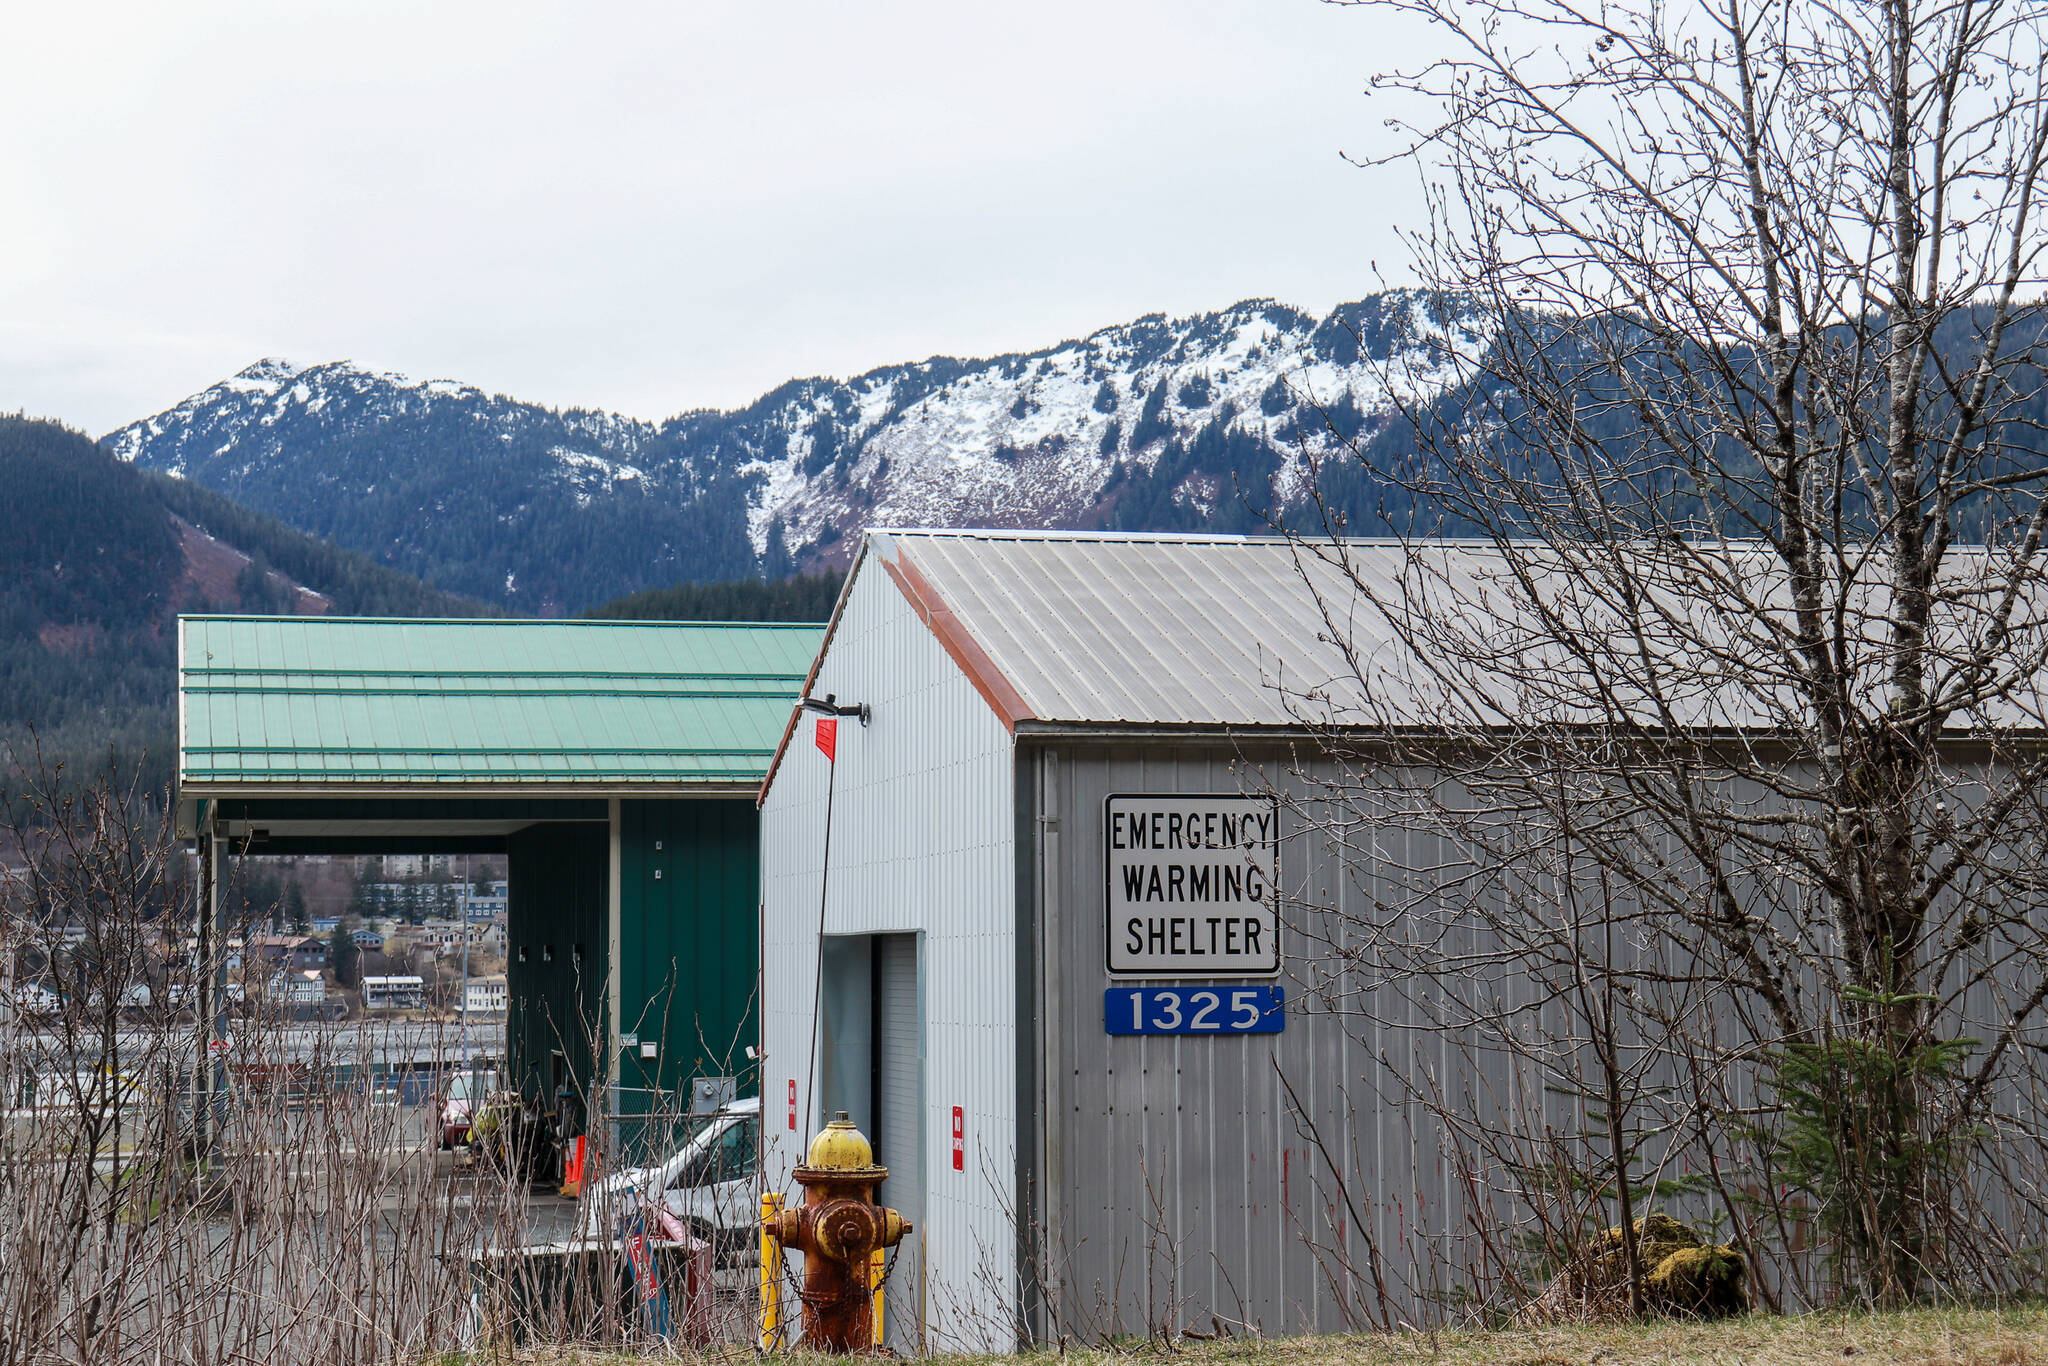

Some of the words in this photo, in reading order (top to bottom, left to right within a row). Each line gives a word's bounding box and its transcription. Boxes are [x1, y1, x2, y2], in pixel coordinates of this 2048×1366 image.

[1113, 812, 1271, 849] EMERGENCY
[1123, 865, 1263, 902] WARMING
[1126, 918, 1262, 955] SHELTER
[1130, 992, 1259, 1029] 1325
